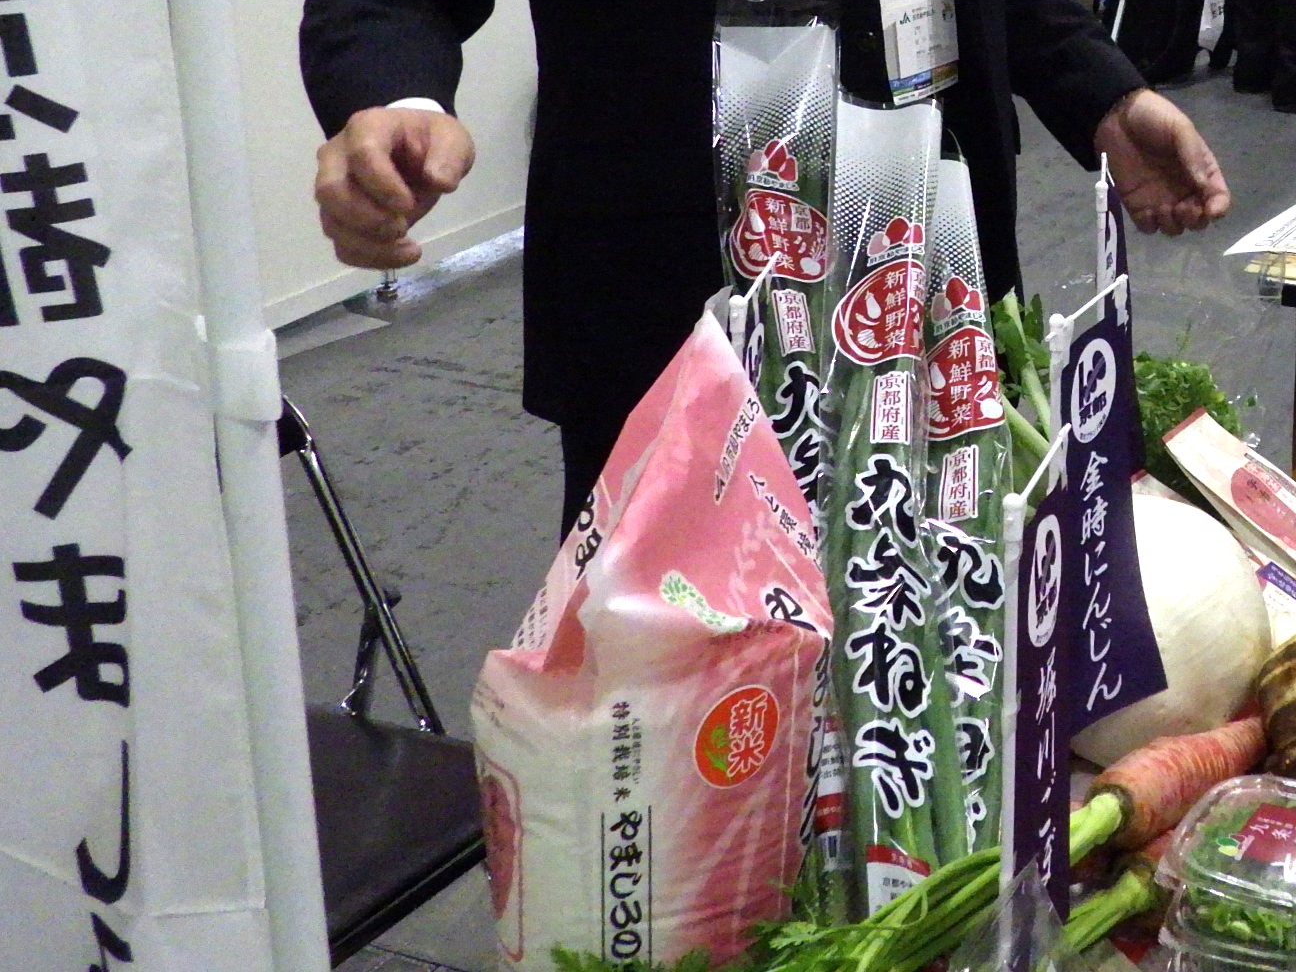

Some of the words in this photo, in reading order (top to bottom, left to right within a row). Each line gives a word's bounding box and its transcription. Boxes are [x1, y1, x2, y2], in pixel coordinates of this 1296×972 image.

[783, 292, 806, 349] 京都府産
[884, 268, 907, 352] 新鮮野菜
[880, 374, 901, 441] 京都府産
[947, 337, 973, 428] 新鮮野菜
[949, 448, 968, 519] 京都府産
[1081, 453, 1123, 712] 金時にんじん
[849, 457, 932, 815] 九条ねぎ
[725, 691, 768, 778] 新米
[609, 809, 643, 961] やましろの
